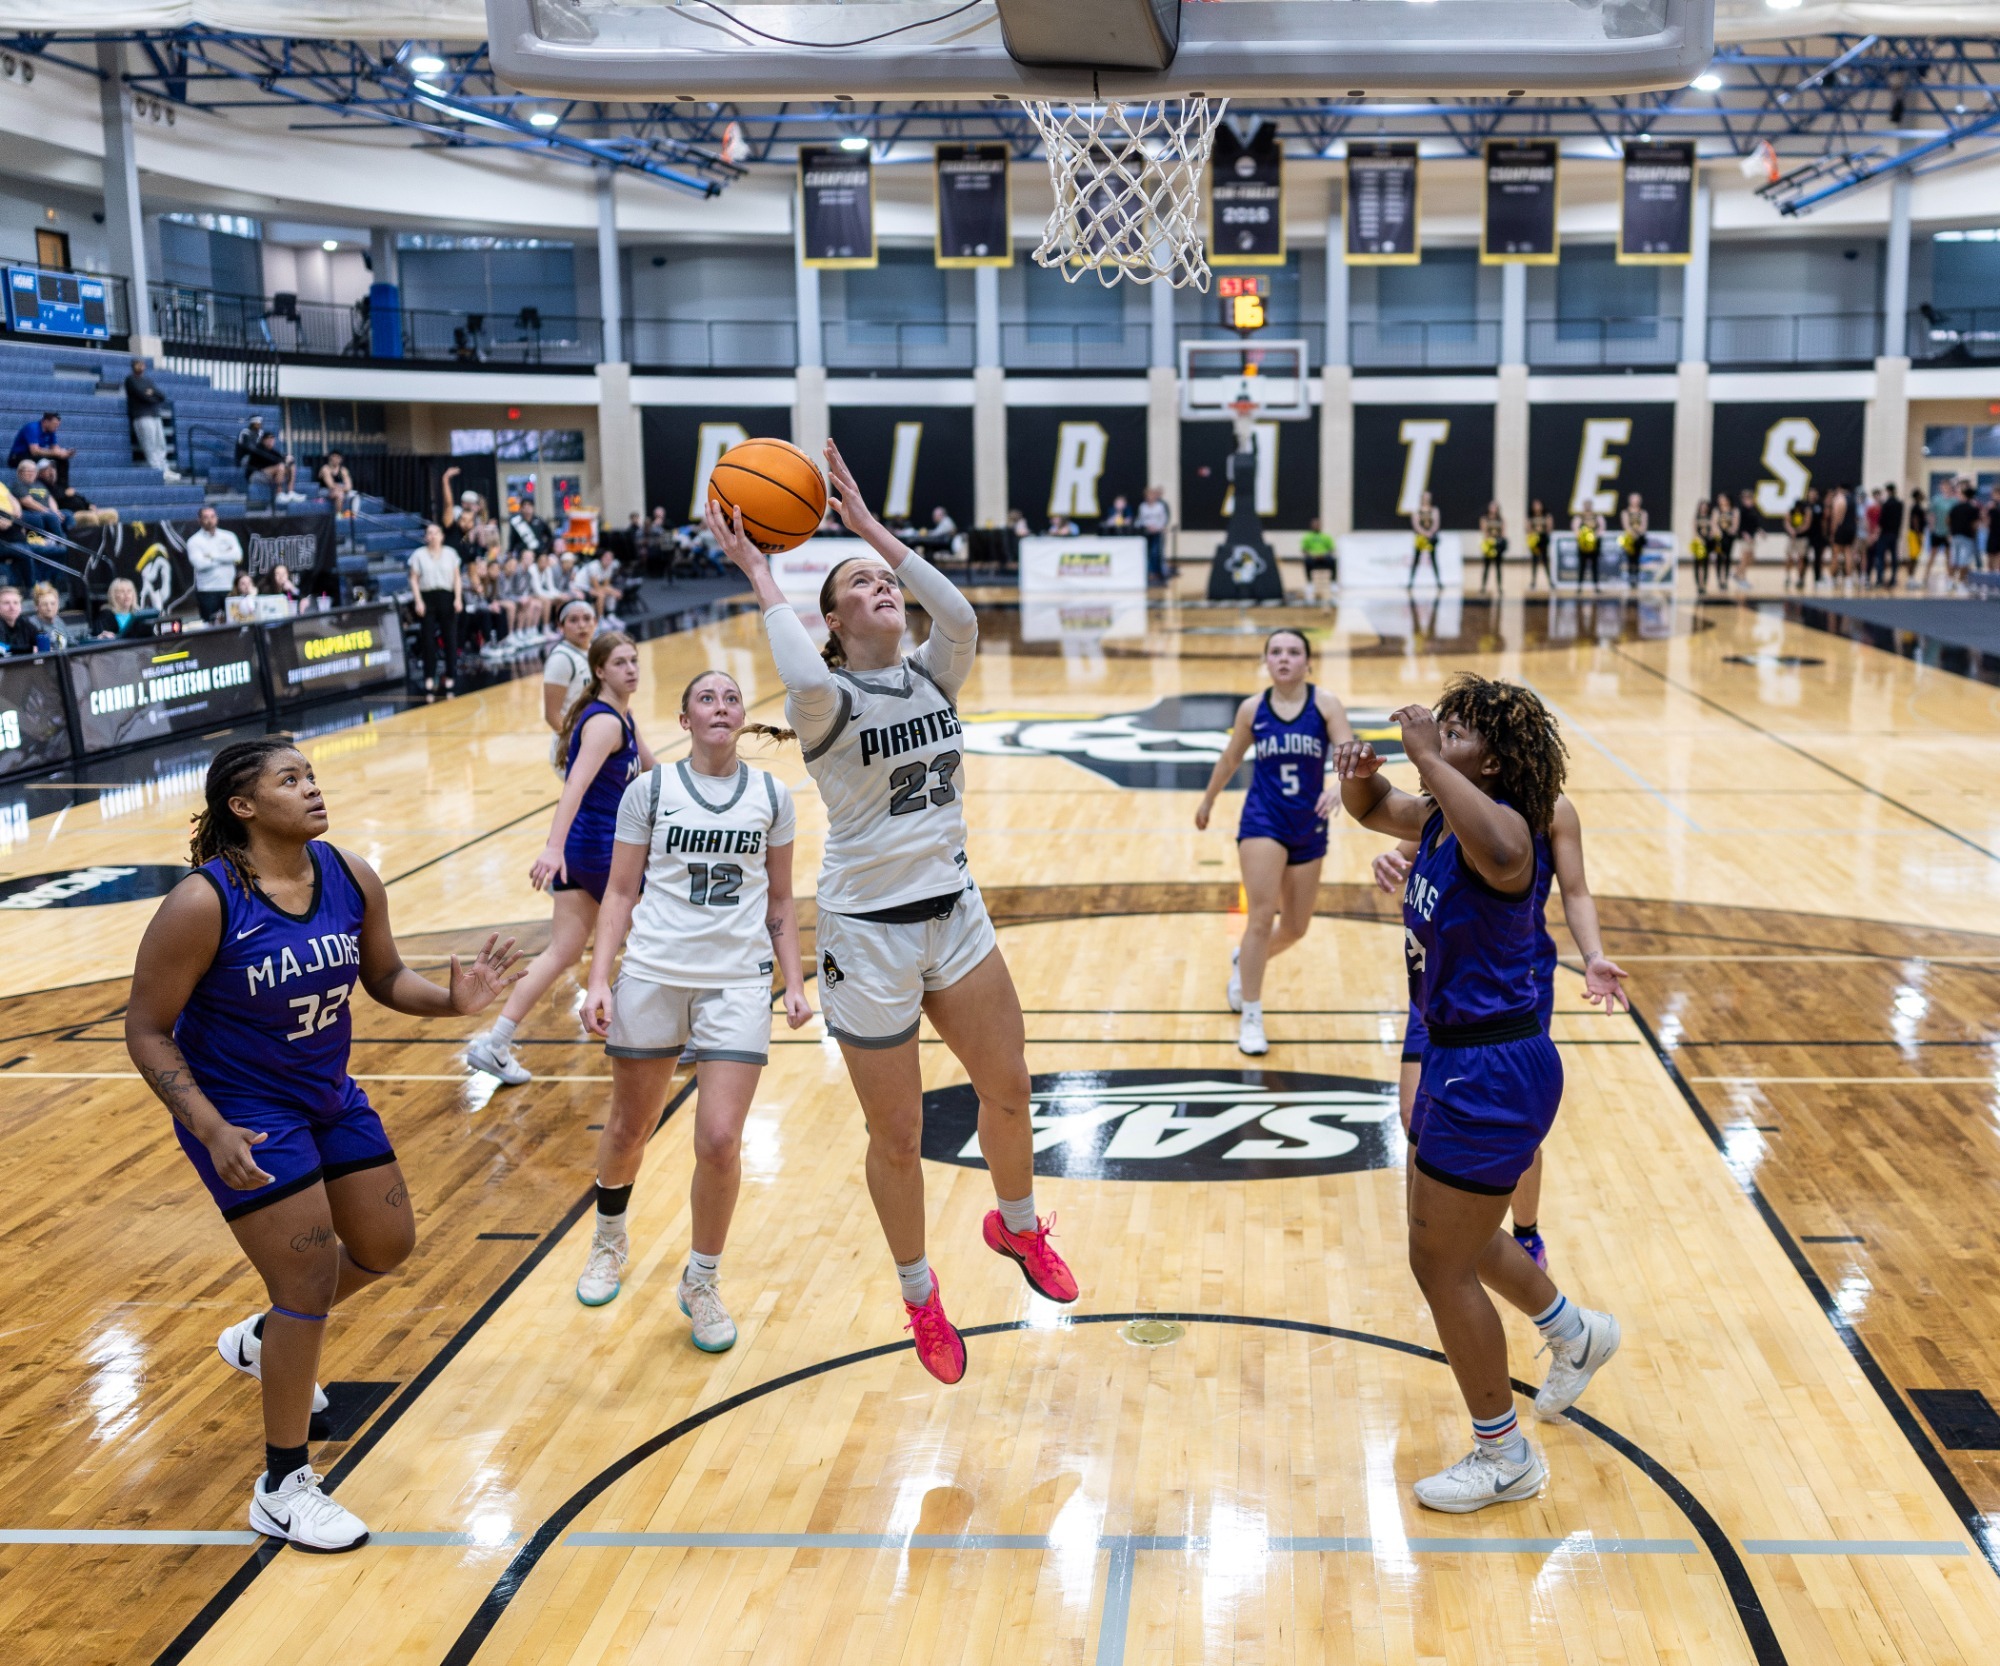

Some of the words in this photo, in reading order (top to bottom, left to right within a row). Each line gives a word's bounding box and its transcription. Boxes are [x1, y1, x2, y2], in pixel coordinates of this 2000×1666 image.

[212, 660, 251, 689] CENTER
[859, 706, 963, 767] PIRATES
[1256, 733, 1323, 761] MAJORS
[889, 749, 962, 817] 23
[1279, 763, 1300, 796] 5
[666, 825, 763, 855] PIRATES
[687, 862, 744, 906] 12
[246, 933, 361, 997] MAJORS
[286, 983, 349, 1042] 32
